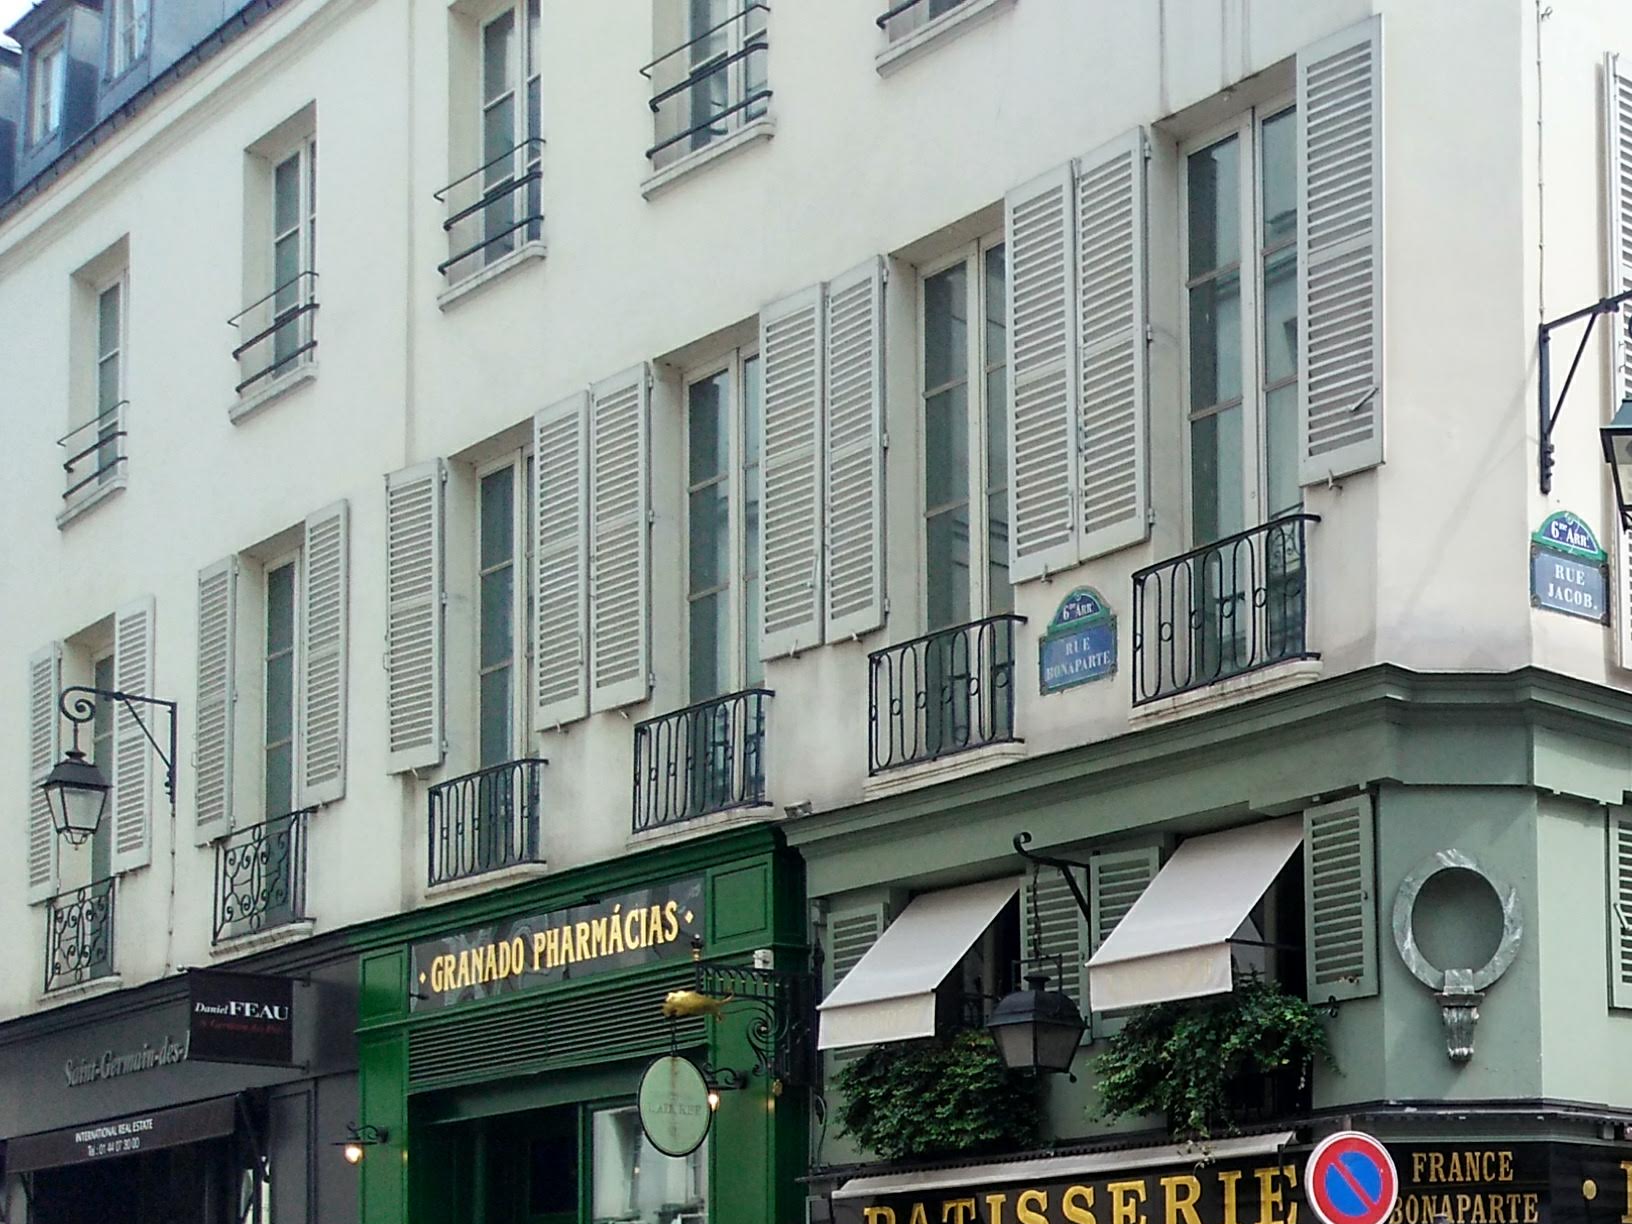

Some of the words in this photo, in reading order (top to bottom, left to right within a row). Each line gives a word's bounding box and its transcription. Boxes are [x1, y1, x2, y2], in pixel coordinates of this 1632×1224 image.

[1555, 564, 1585, 586] RUE
[1065, 637, 1090, 656] RUE
[1046, 650, 1111, 680] BONAPARTE
[431, 936, 525, 993] GRANADO
[533, 900, 679, 971] PHARMÁCIAS
[195, 1002, 229, 1015] Daniel
[229, 1001, 289, 1021] FEAU
[132, 1118, 153, 1132] ESTATE
[1412, 1151, 1513, 1183] FRANCE
